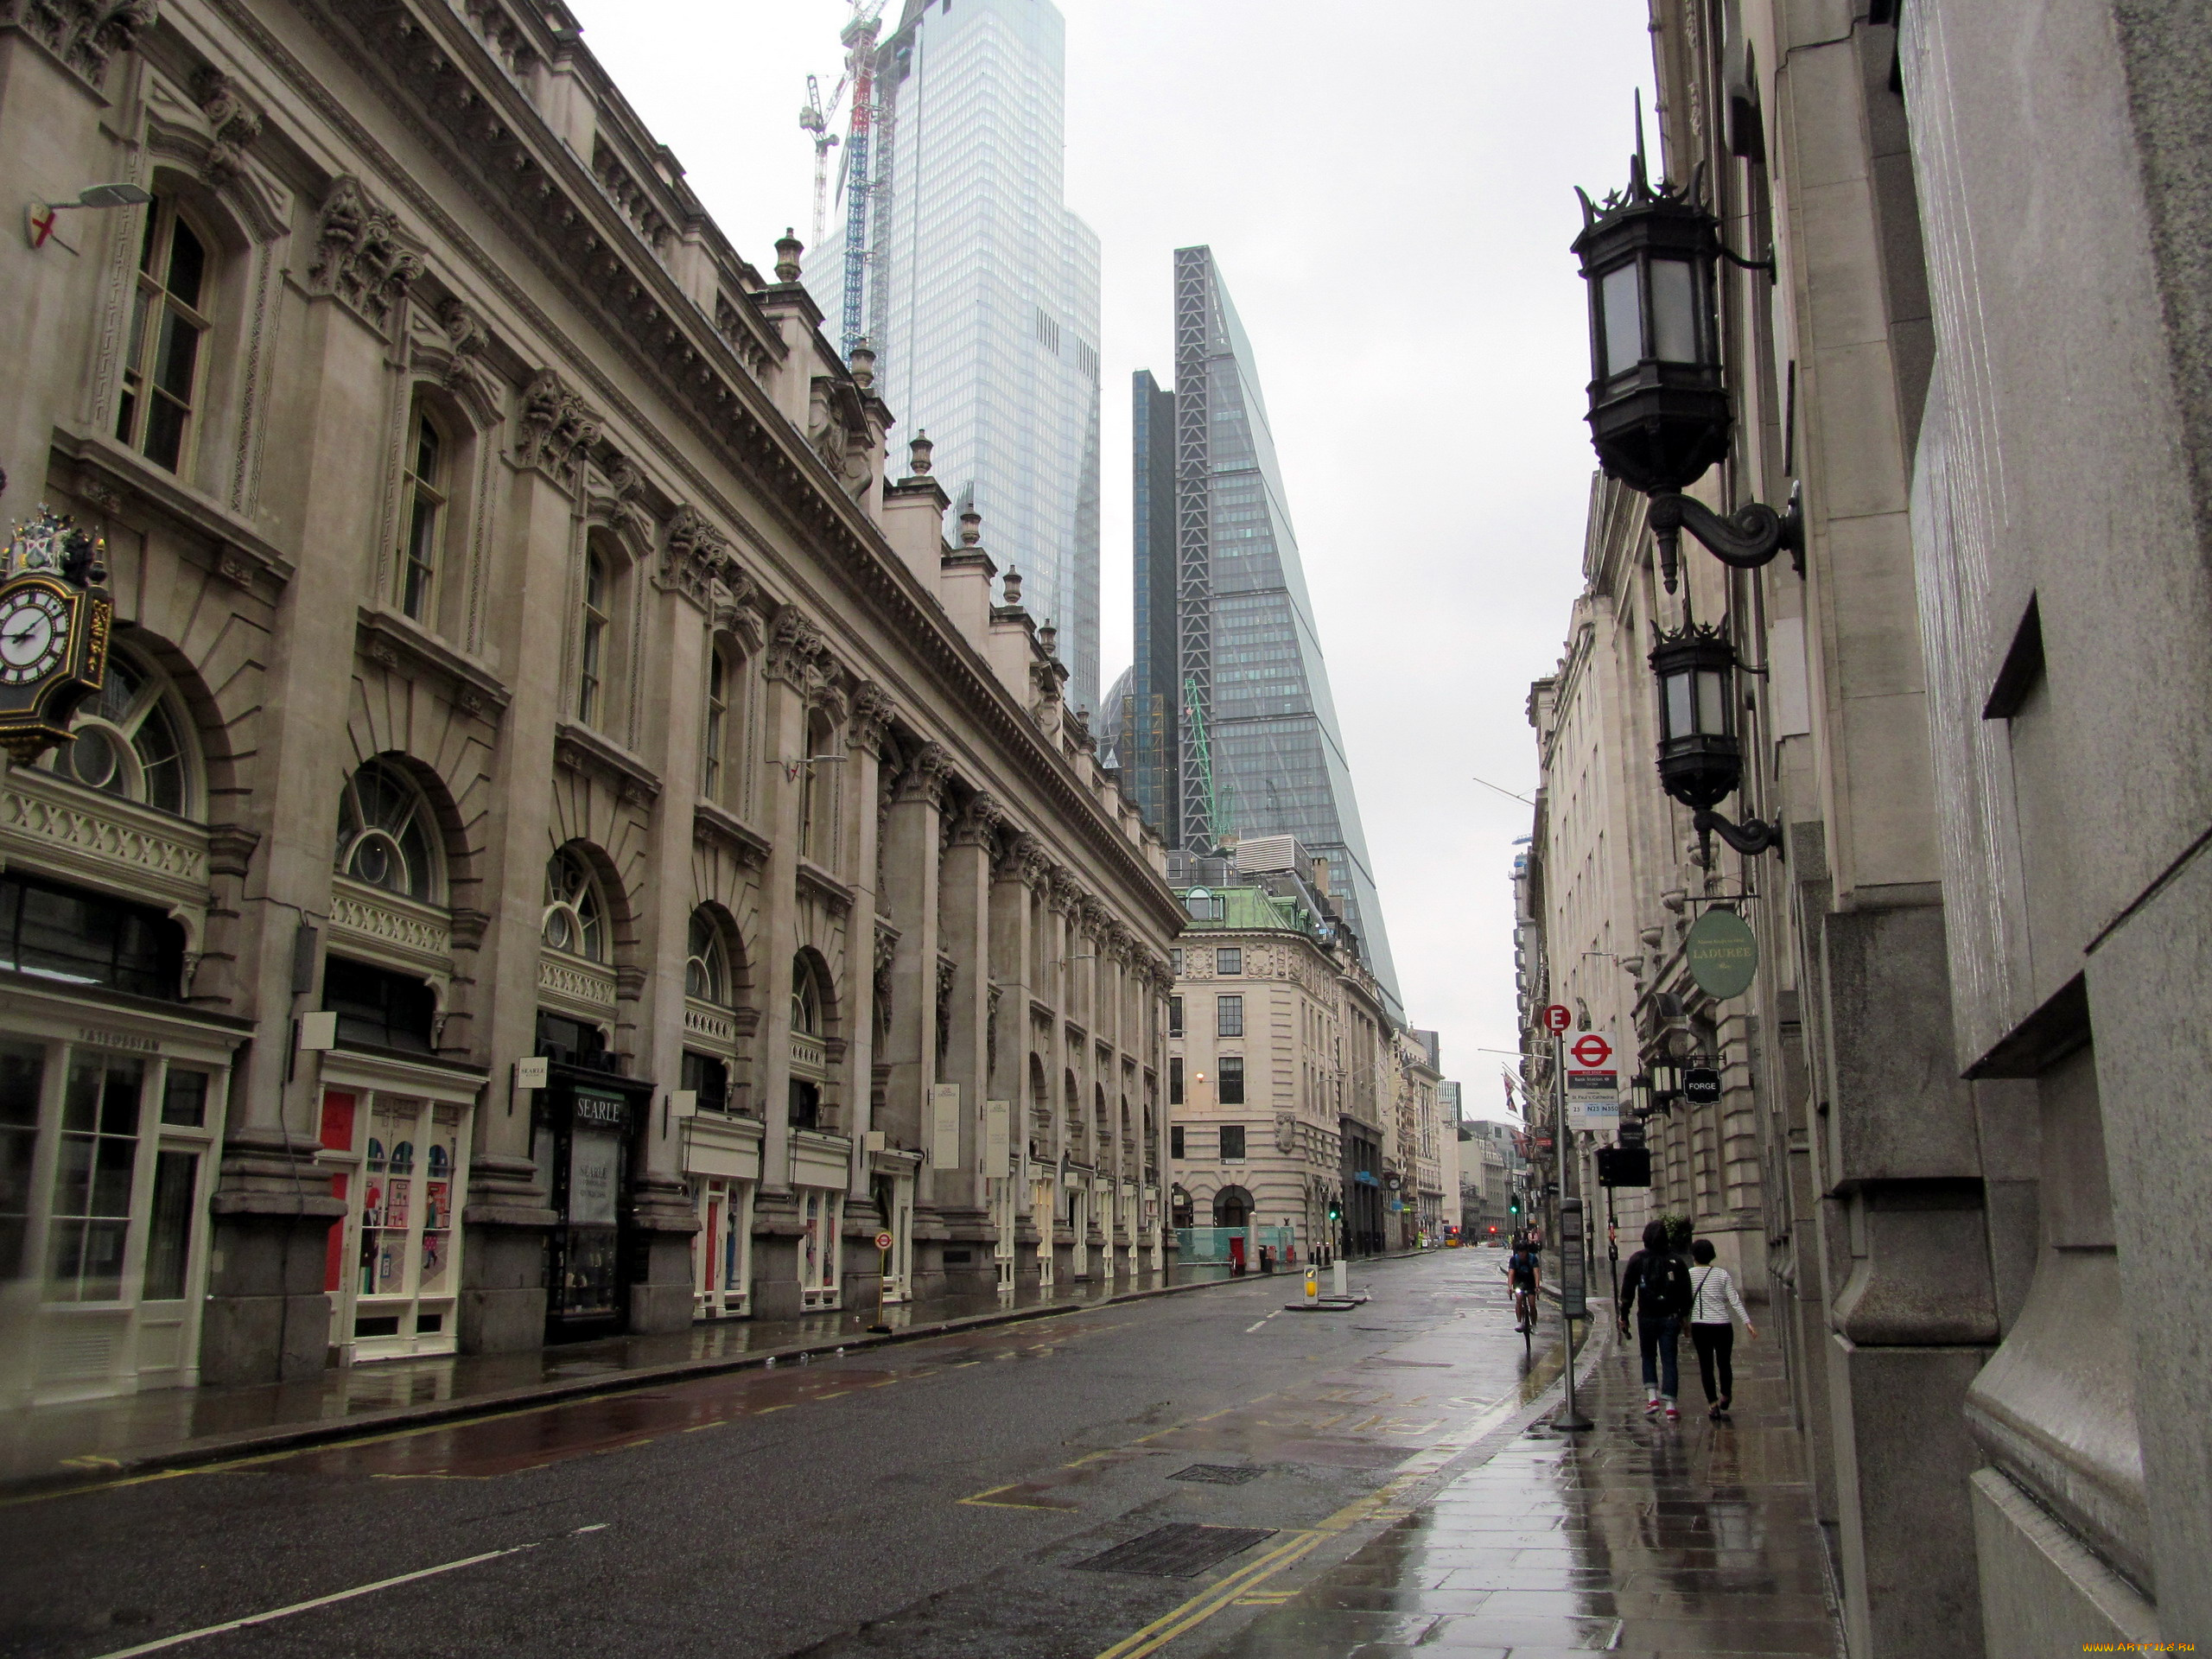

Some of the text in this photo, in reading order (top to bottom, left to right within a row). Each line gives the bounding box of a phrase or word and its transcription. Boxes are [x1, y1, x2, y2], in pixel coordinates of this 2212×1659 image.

[1550, 1009, 1564, 1029] E
[1688, 1082, 1717, 1090] FORGE
[577, 1097, 620, 1122] SEARLE
